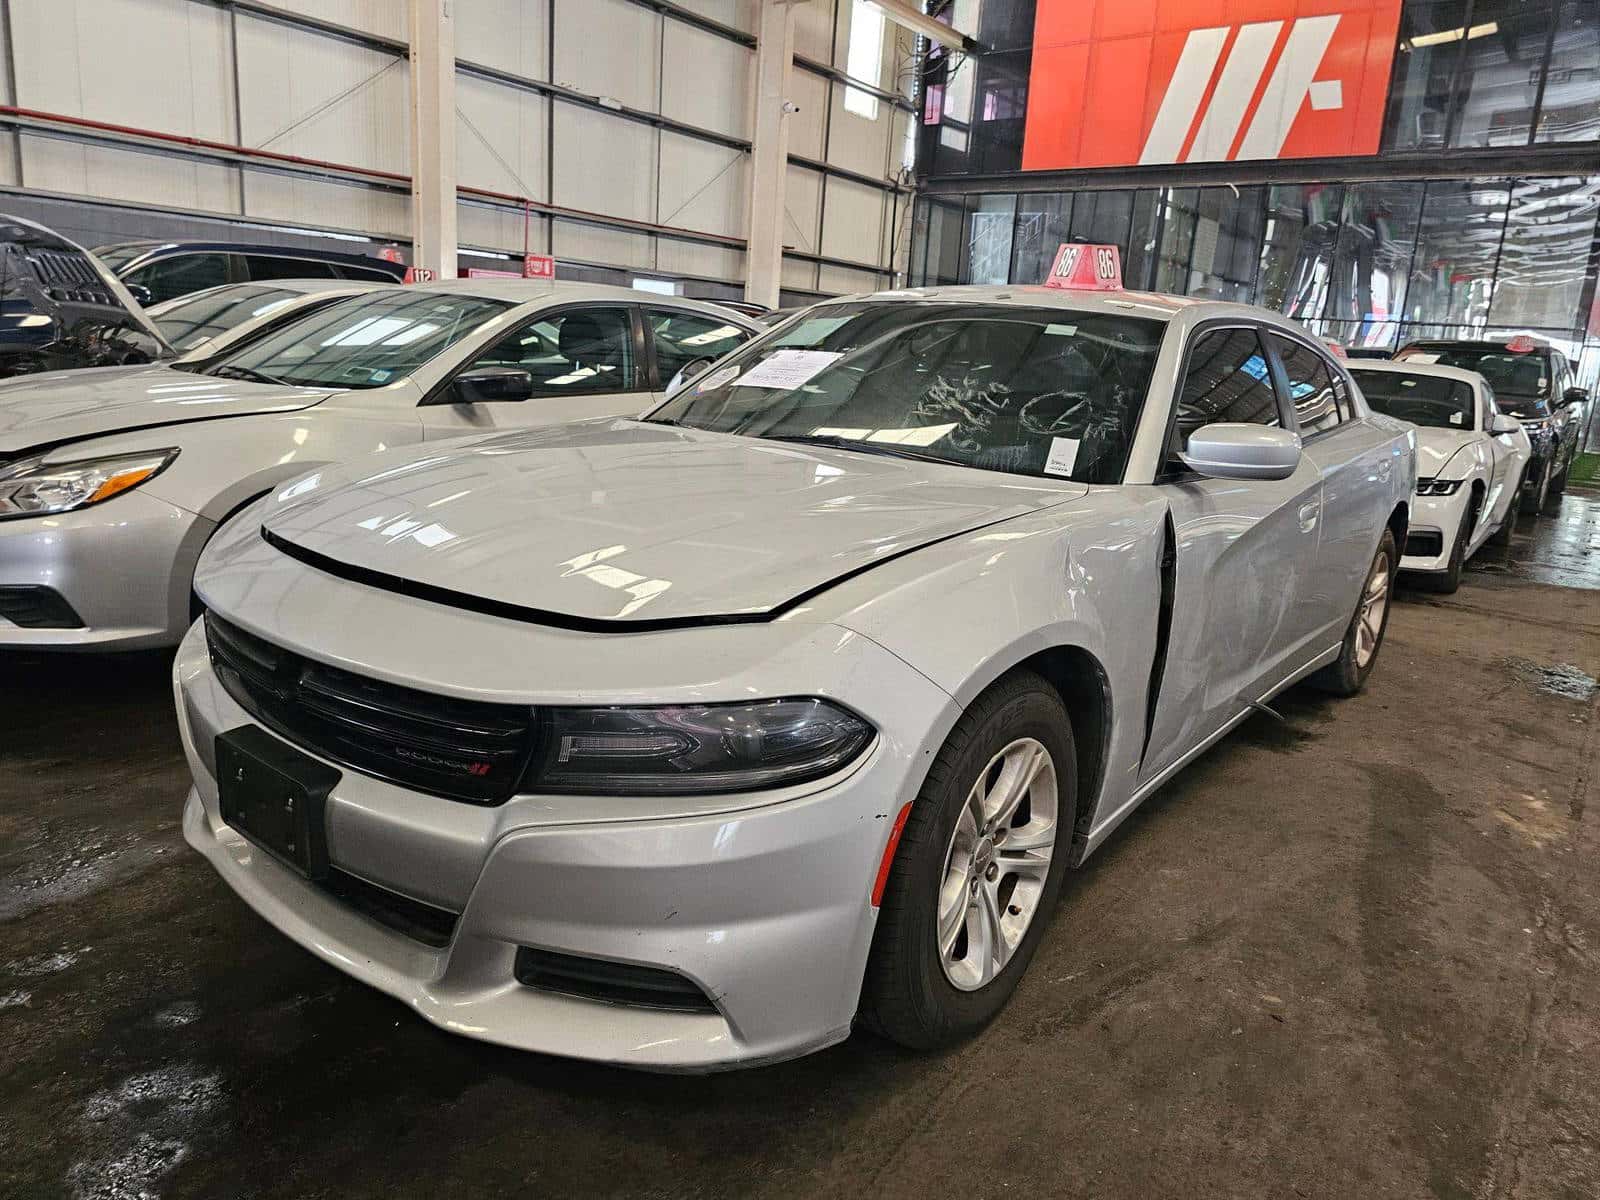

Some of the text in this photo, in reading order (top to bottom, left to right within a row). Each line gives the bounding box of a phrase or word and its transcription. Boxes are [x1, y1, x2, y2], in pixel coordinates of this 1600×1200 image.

[414, 269, 431, 283] 112
[1056, 247, 1078, 277] 86
[1098, 248, 1115, 278] 86
